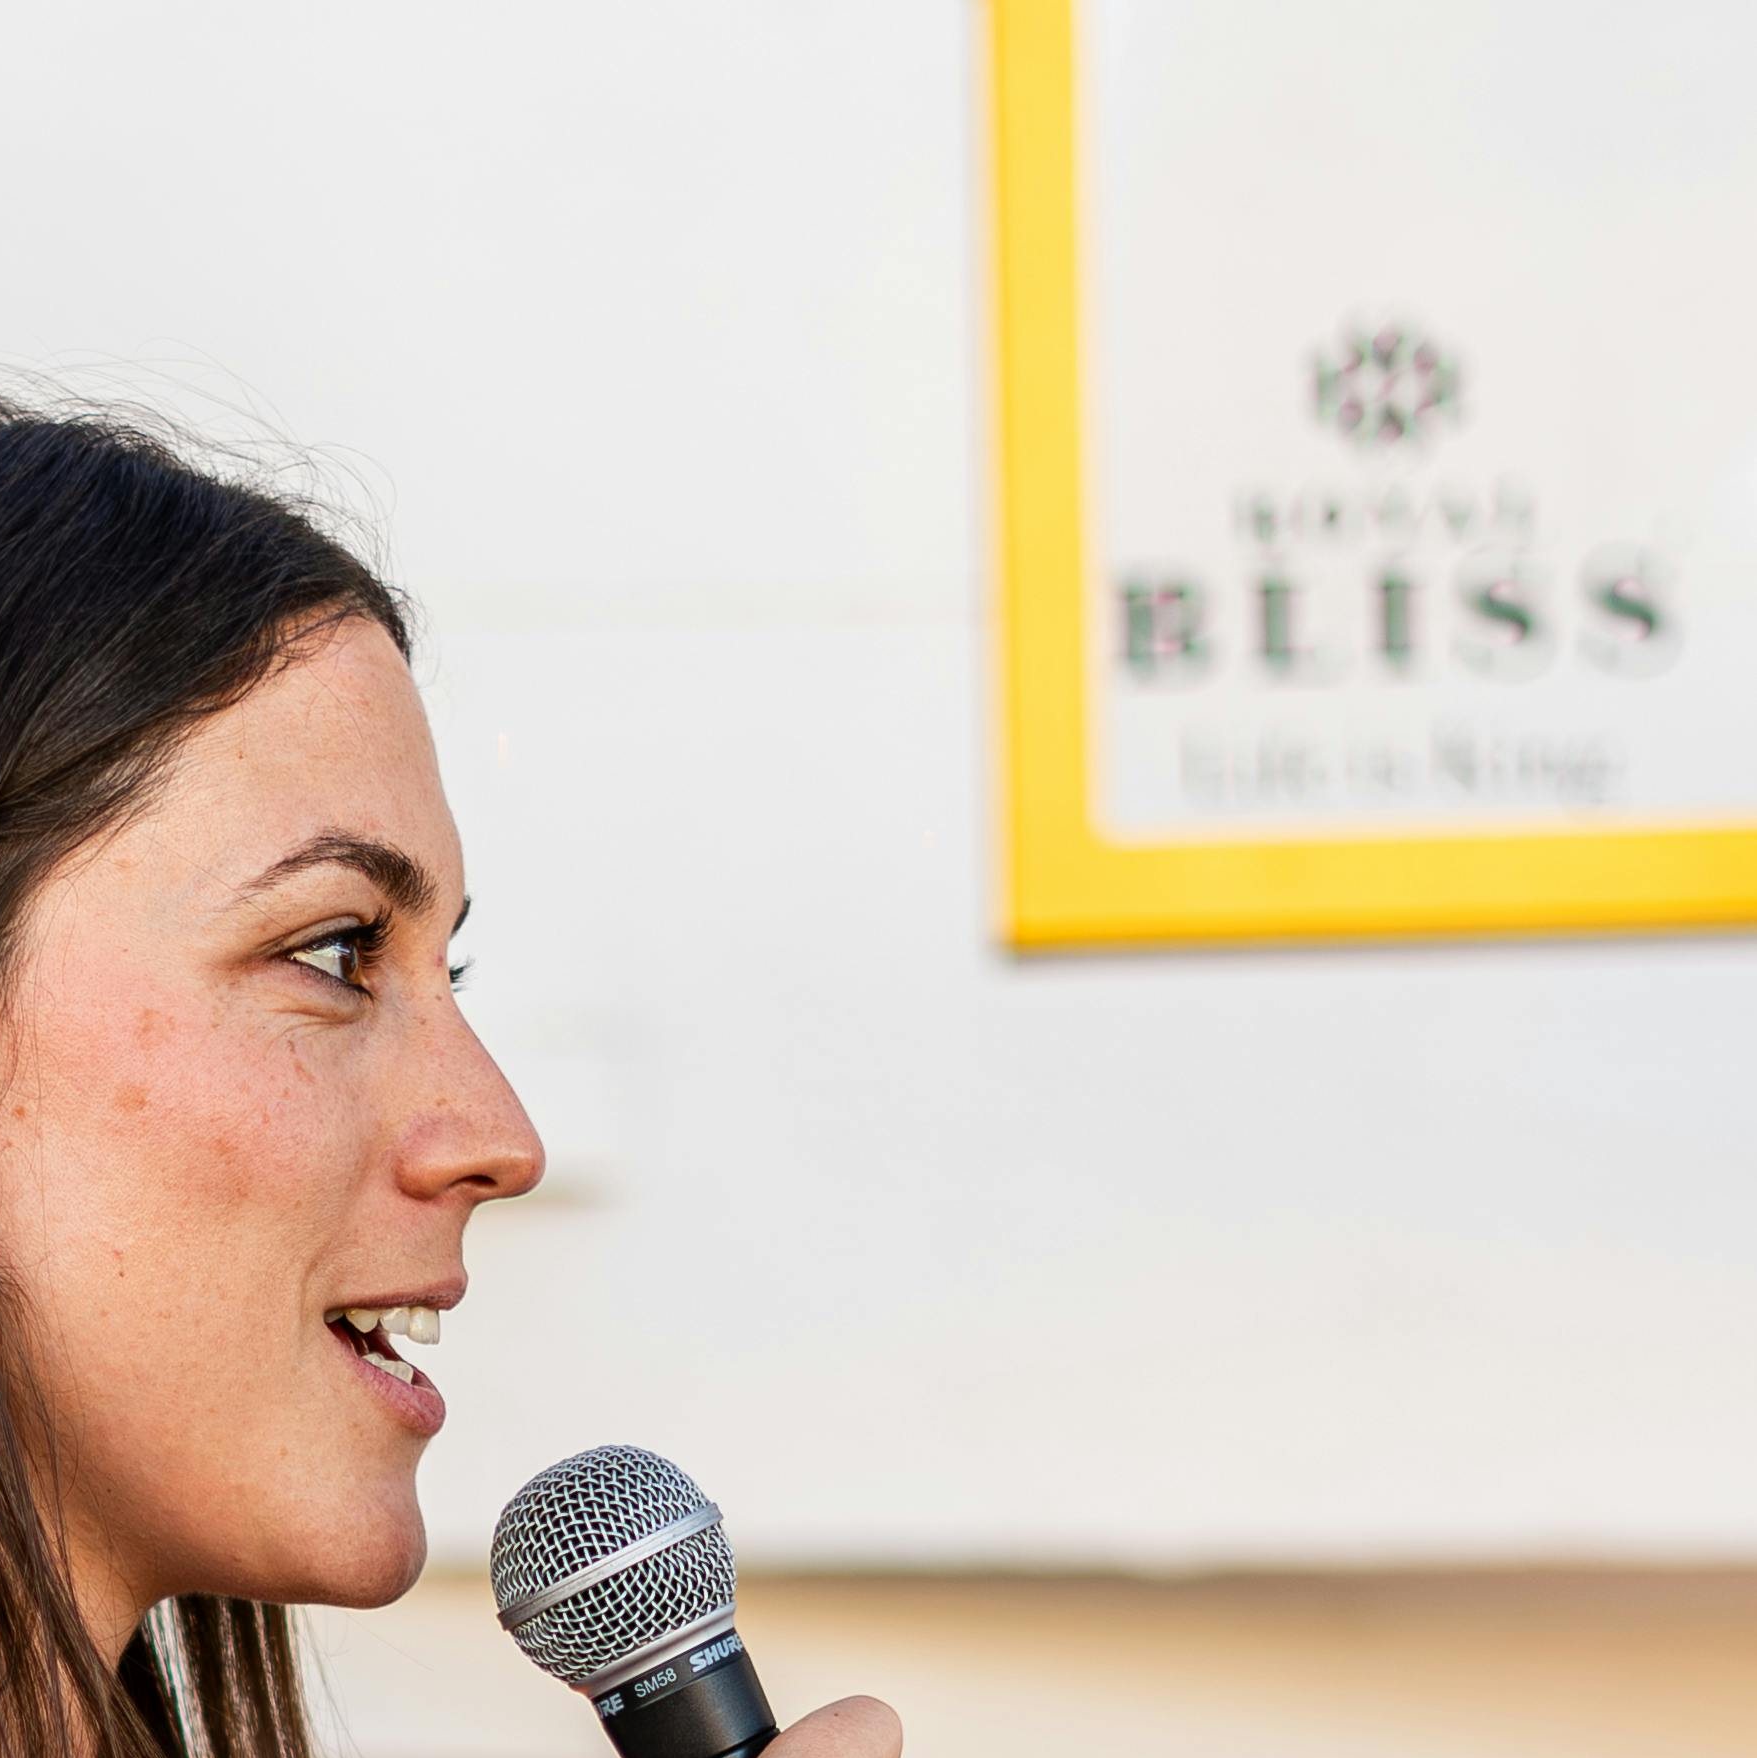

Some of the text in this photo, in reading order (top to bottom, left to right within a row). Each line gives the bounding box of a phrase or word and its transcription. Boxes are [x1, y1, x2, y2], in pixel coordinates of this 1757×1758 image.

[1115, 550, 1680, 688] BLISS
[633, 1666, 678, 1699] SM58
[688, 1633, 742, 1673] SHURE
